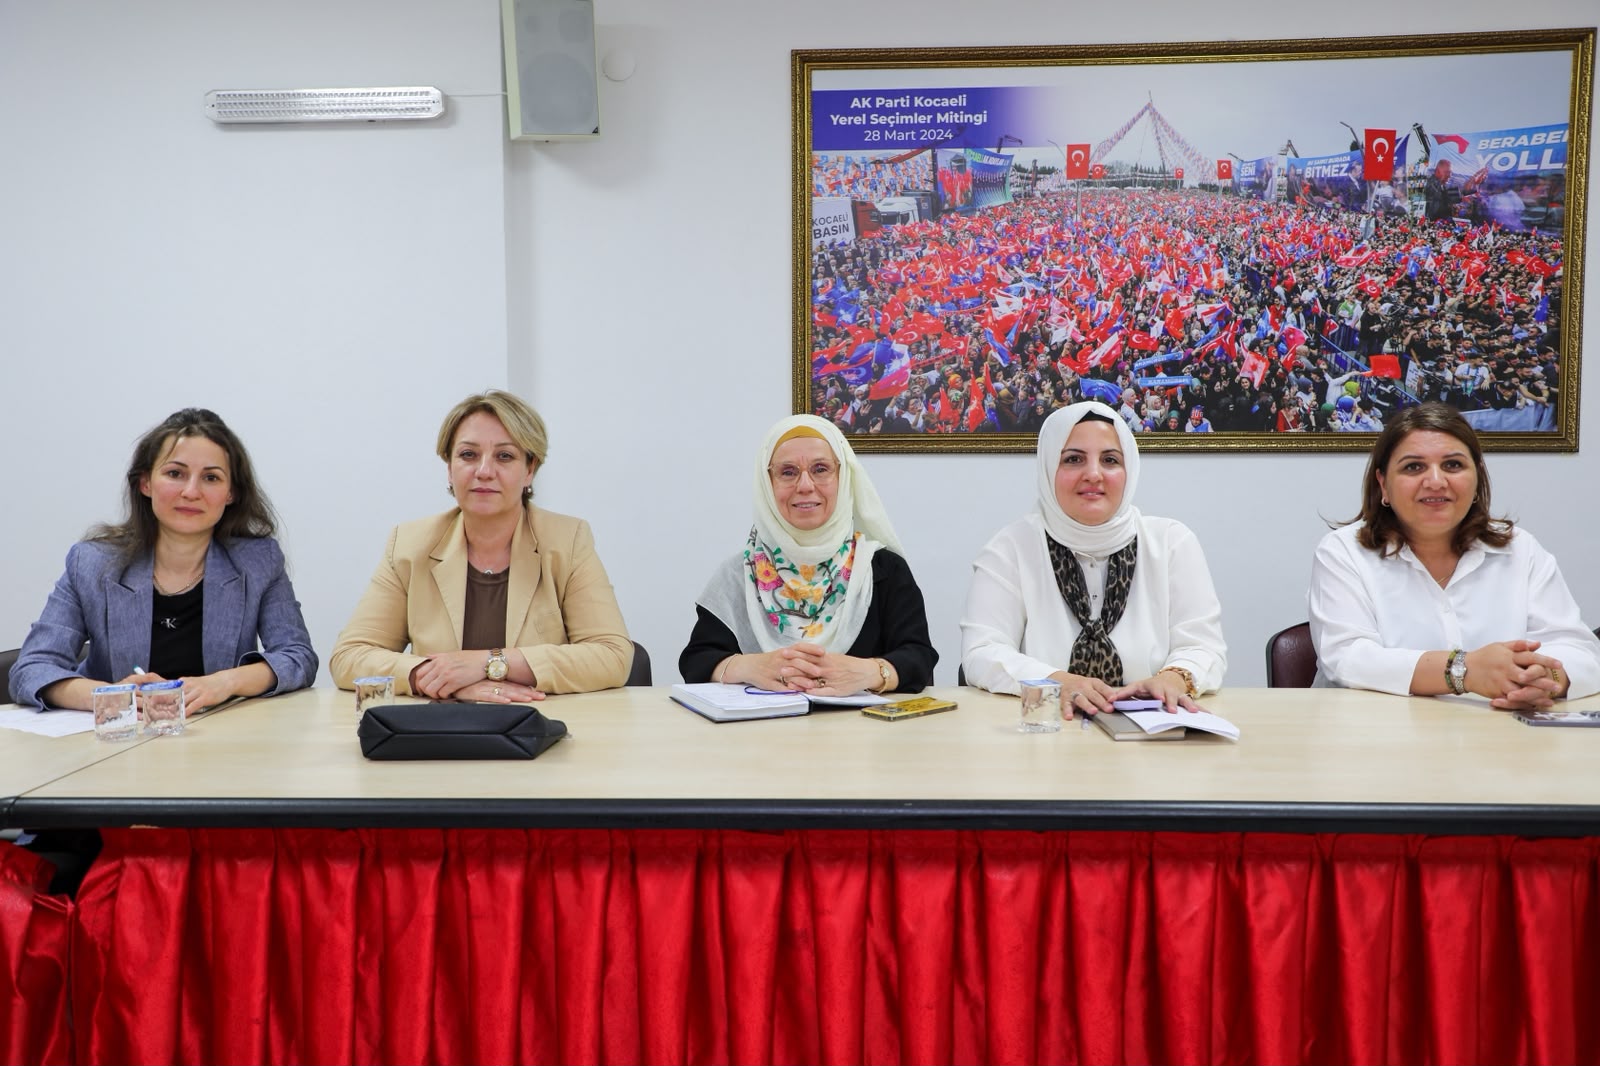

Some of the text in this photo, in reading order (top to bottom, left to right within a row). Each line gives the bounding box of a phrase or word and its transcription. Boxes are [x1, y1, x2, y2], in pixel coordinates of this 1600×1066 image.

[850, 94, 967, 109] AK Parti Kocaeli
[830, 110, 988, 128] Yerel Seçimler Mitingi
[864, 128, 954, 142] 28 Mart 2024
[1475, 148, 1567, 172] YOLL
[813, 223, 850, 239] BASIN
